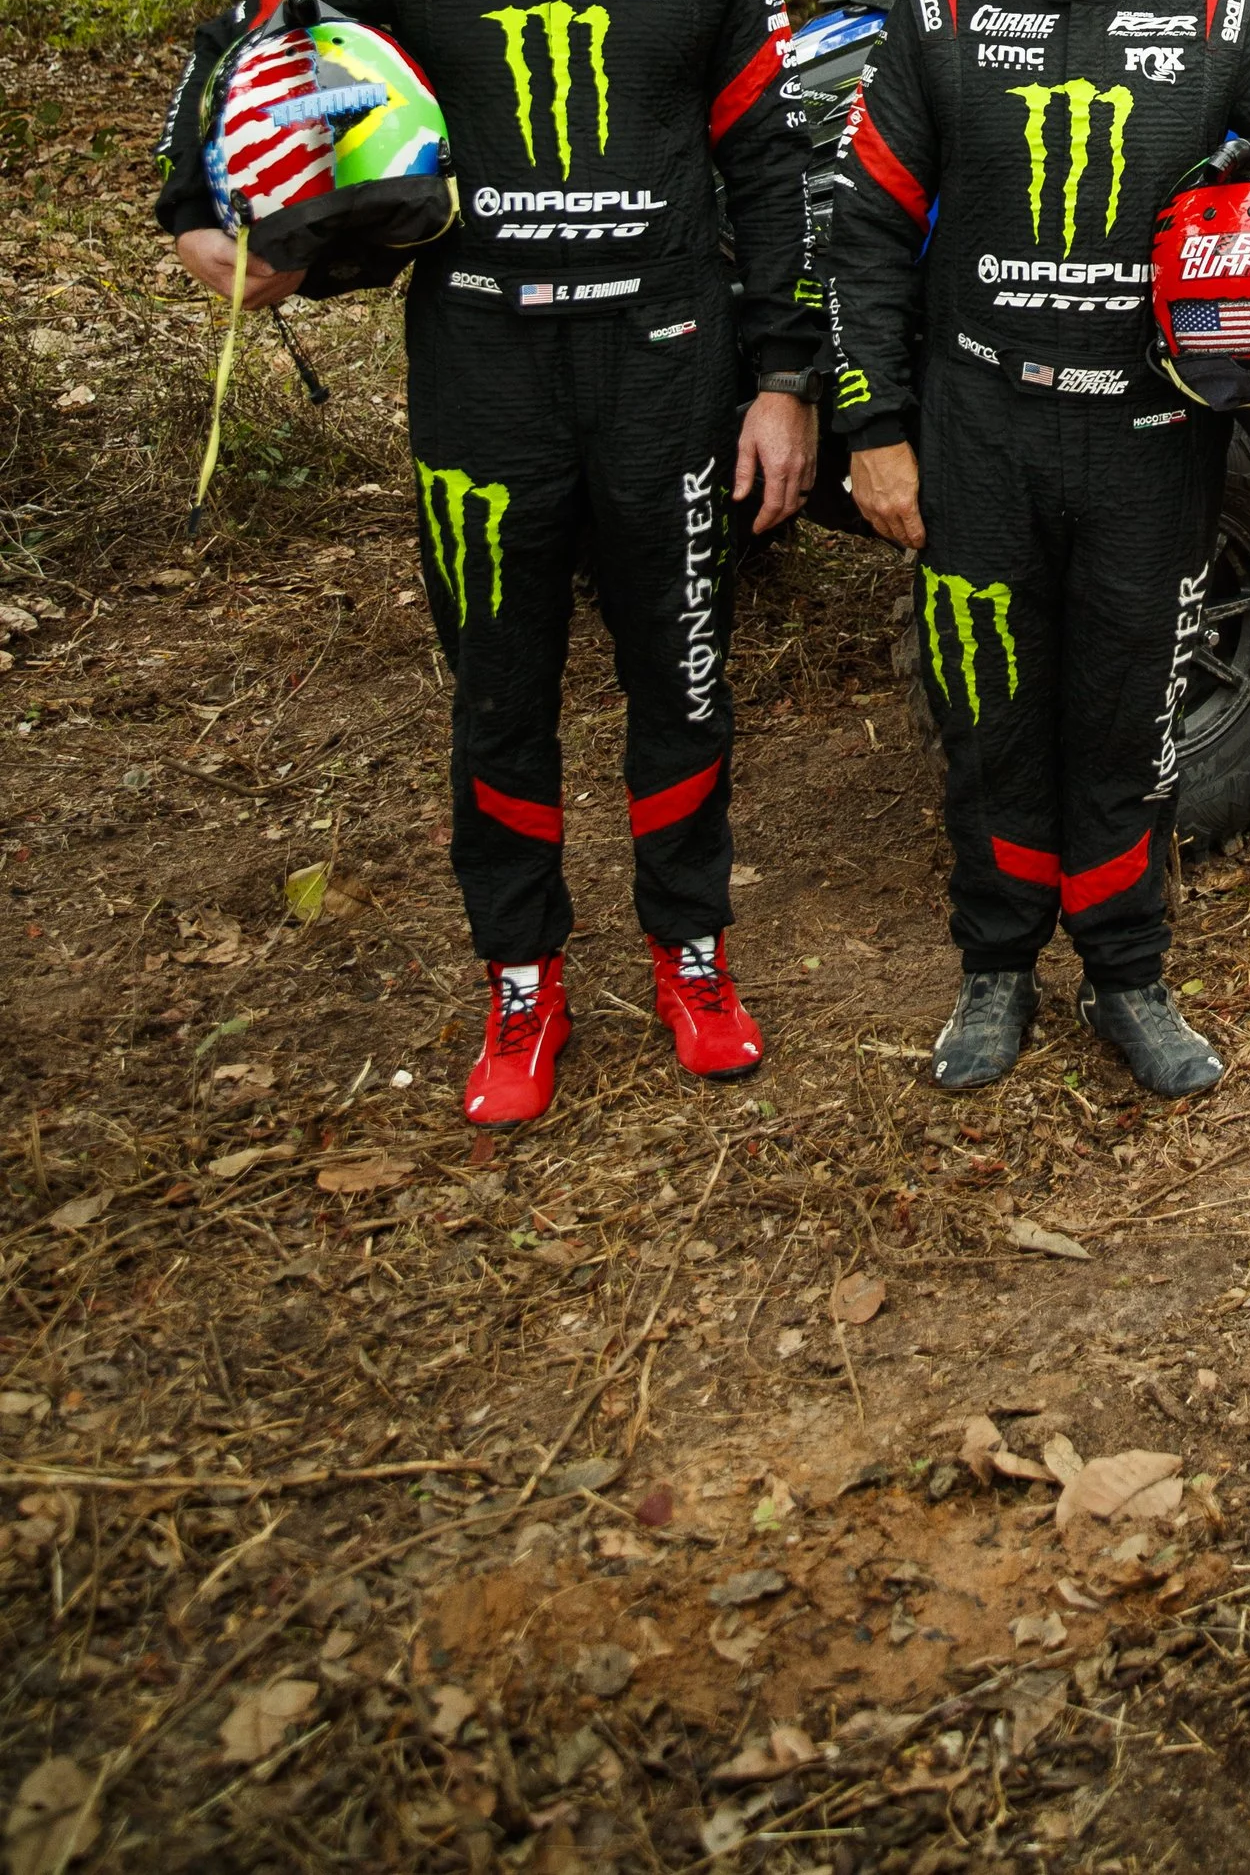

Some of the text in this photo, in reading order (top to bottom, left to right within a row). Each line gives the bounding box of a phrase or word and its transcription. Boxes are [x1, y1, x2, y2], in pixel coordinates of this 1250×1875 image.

[970, 4, 1060, 33] CURRIE
[985, 30, 1049, 39] ENTERPRISES
[977, 43, 1045, 65] KMC
[978, 61, 1045, 72] WHEELS
[1124, 46, 1186, 85] FOX
[502, 190, 665, 213] MAGPUL
[496, 222, 648, 239] NITTO
[573, 278, 641, 301] BERRIMAN
[993, 291, 1141, 312] NITTO
[1057, 380, 1129, 395] CURRIE
[680, 456, 715, 722] MONSTER
